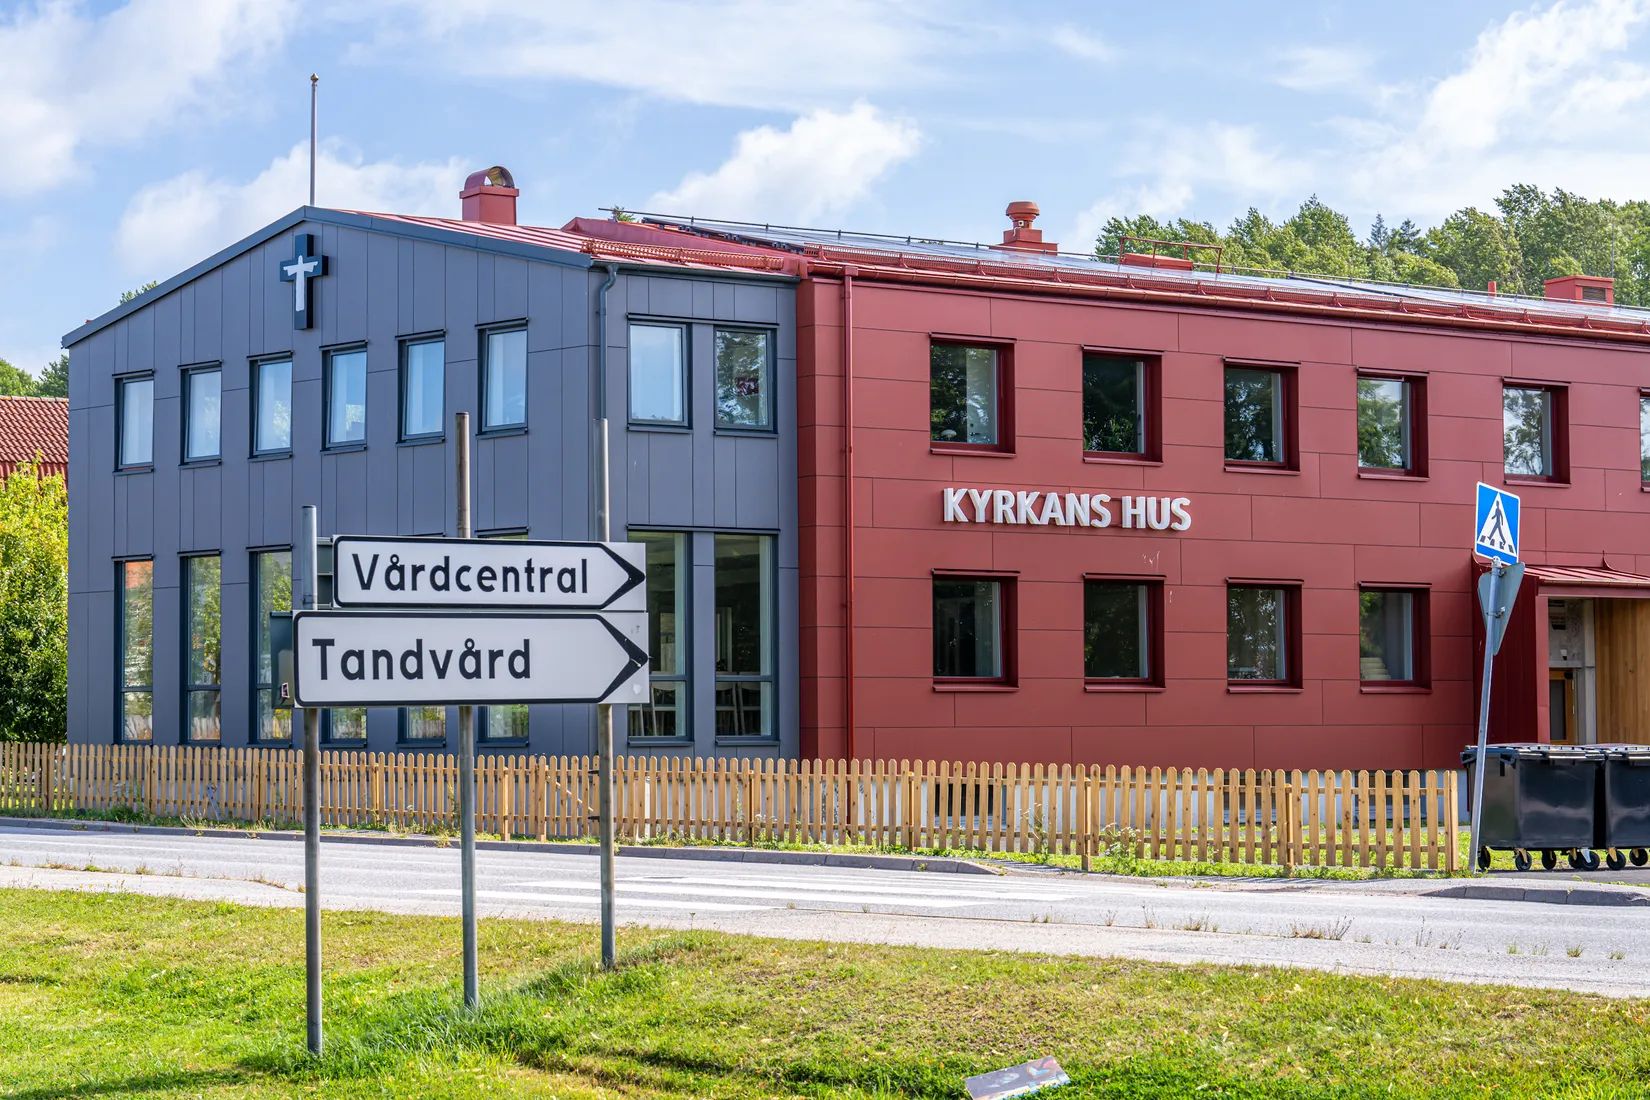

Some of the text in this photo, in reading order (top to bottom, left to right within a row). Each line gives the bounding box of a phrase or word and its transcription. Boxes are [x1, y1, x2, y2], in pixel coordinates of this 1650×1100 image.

[943, 487, 1192, 531] KYRKANS HUS
[352, 553, 588, 594] Vårdcentral
[311, 638, 531, 681] Tandvård
